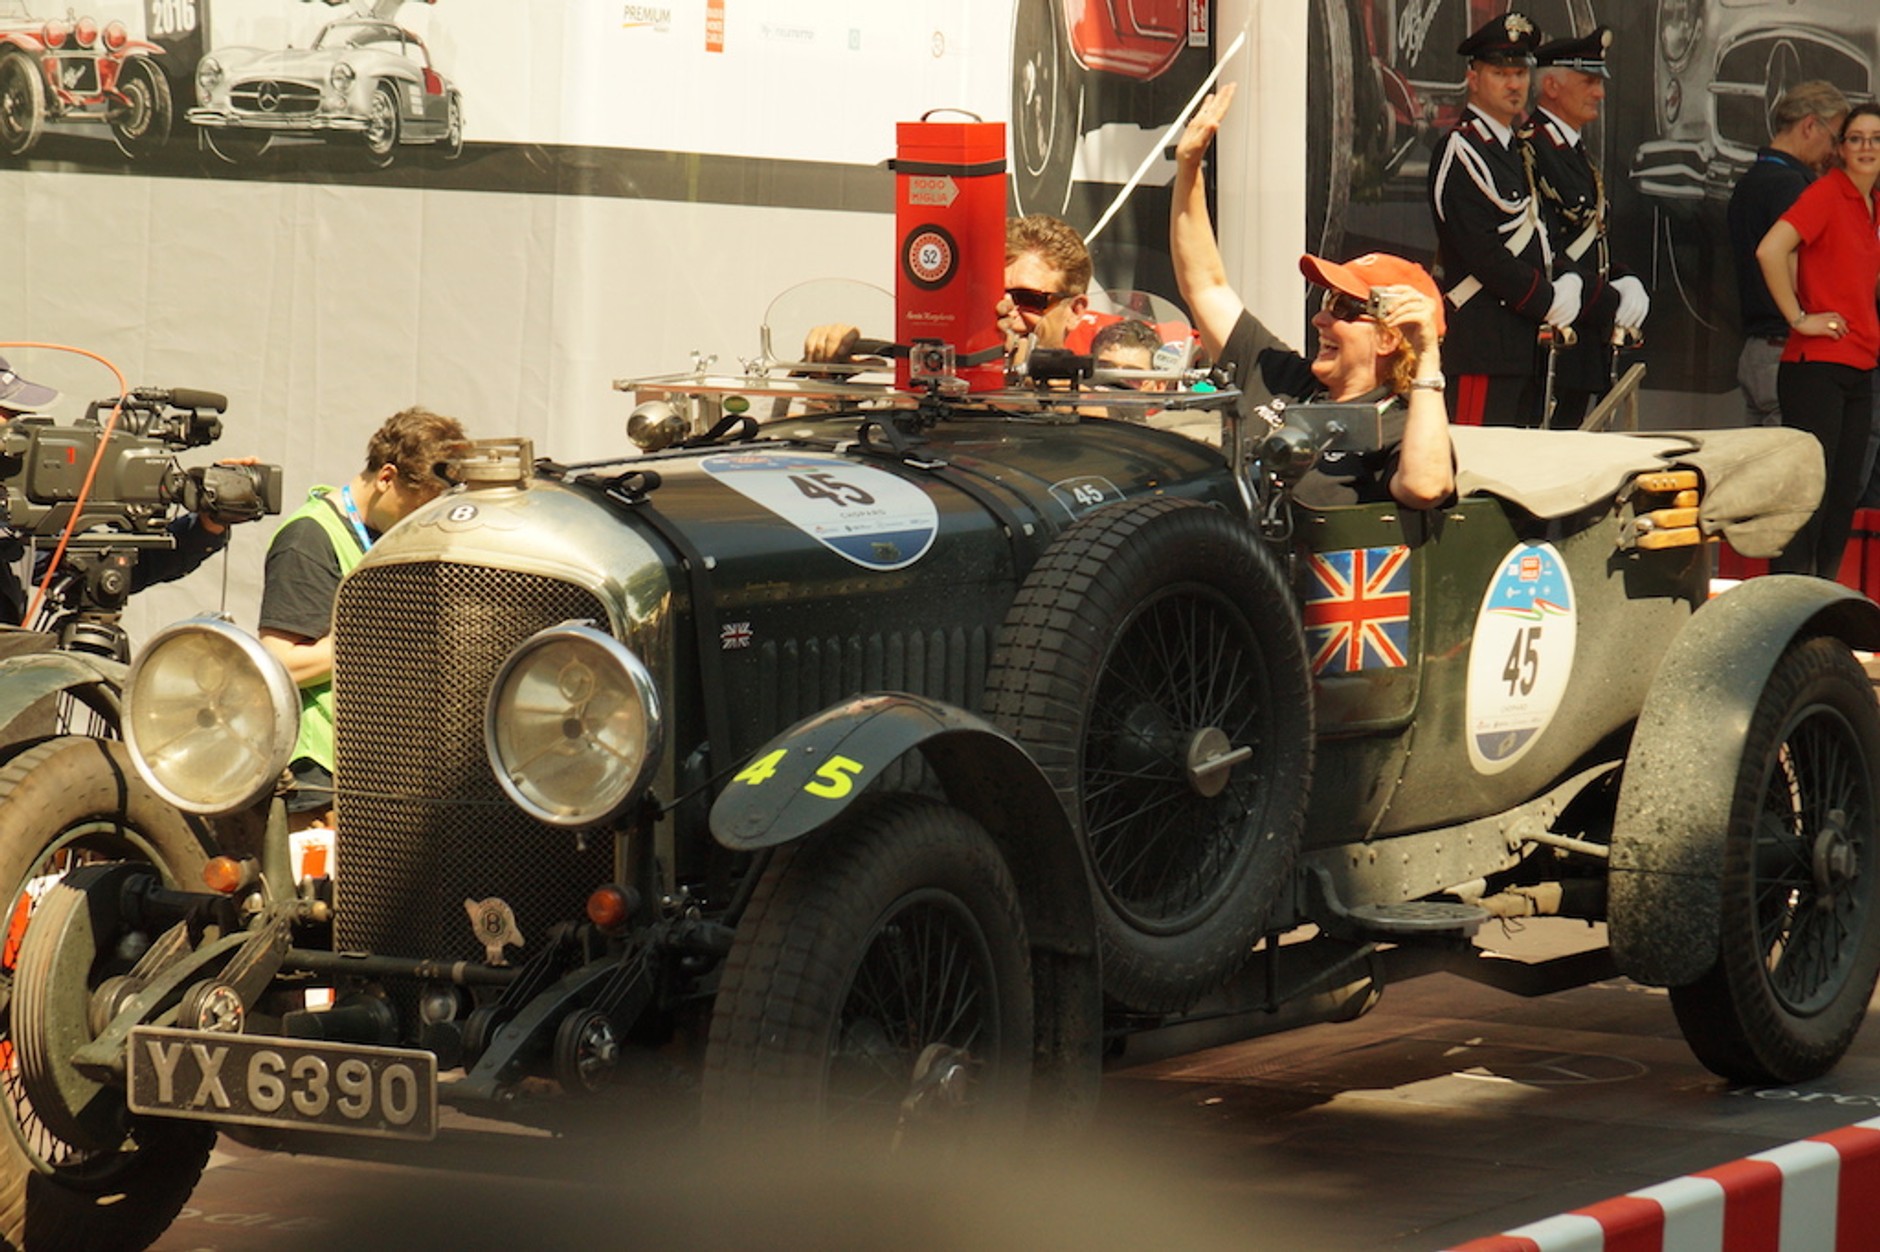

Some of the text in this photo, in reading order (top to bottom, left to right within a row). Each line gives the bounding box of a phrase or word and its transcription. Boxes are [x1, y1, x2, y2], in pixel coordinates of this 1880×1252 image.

[152, 0, 195, 34] 2016
[623, 5, 671, 23] PREMIUM
[914, 180, 945, 190] 1000
[912, 193, 948, 203] MIGLIA
[923, 249, 938, 264] 52
[788, 473, 875, 507] 45
[1073, 484, 1104, 505] 45
[1502, 627, 1541, 696] 45
[146, 1040, 418, 1125] YX 6390
